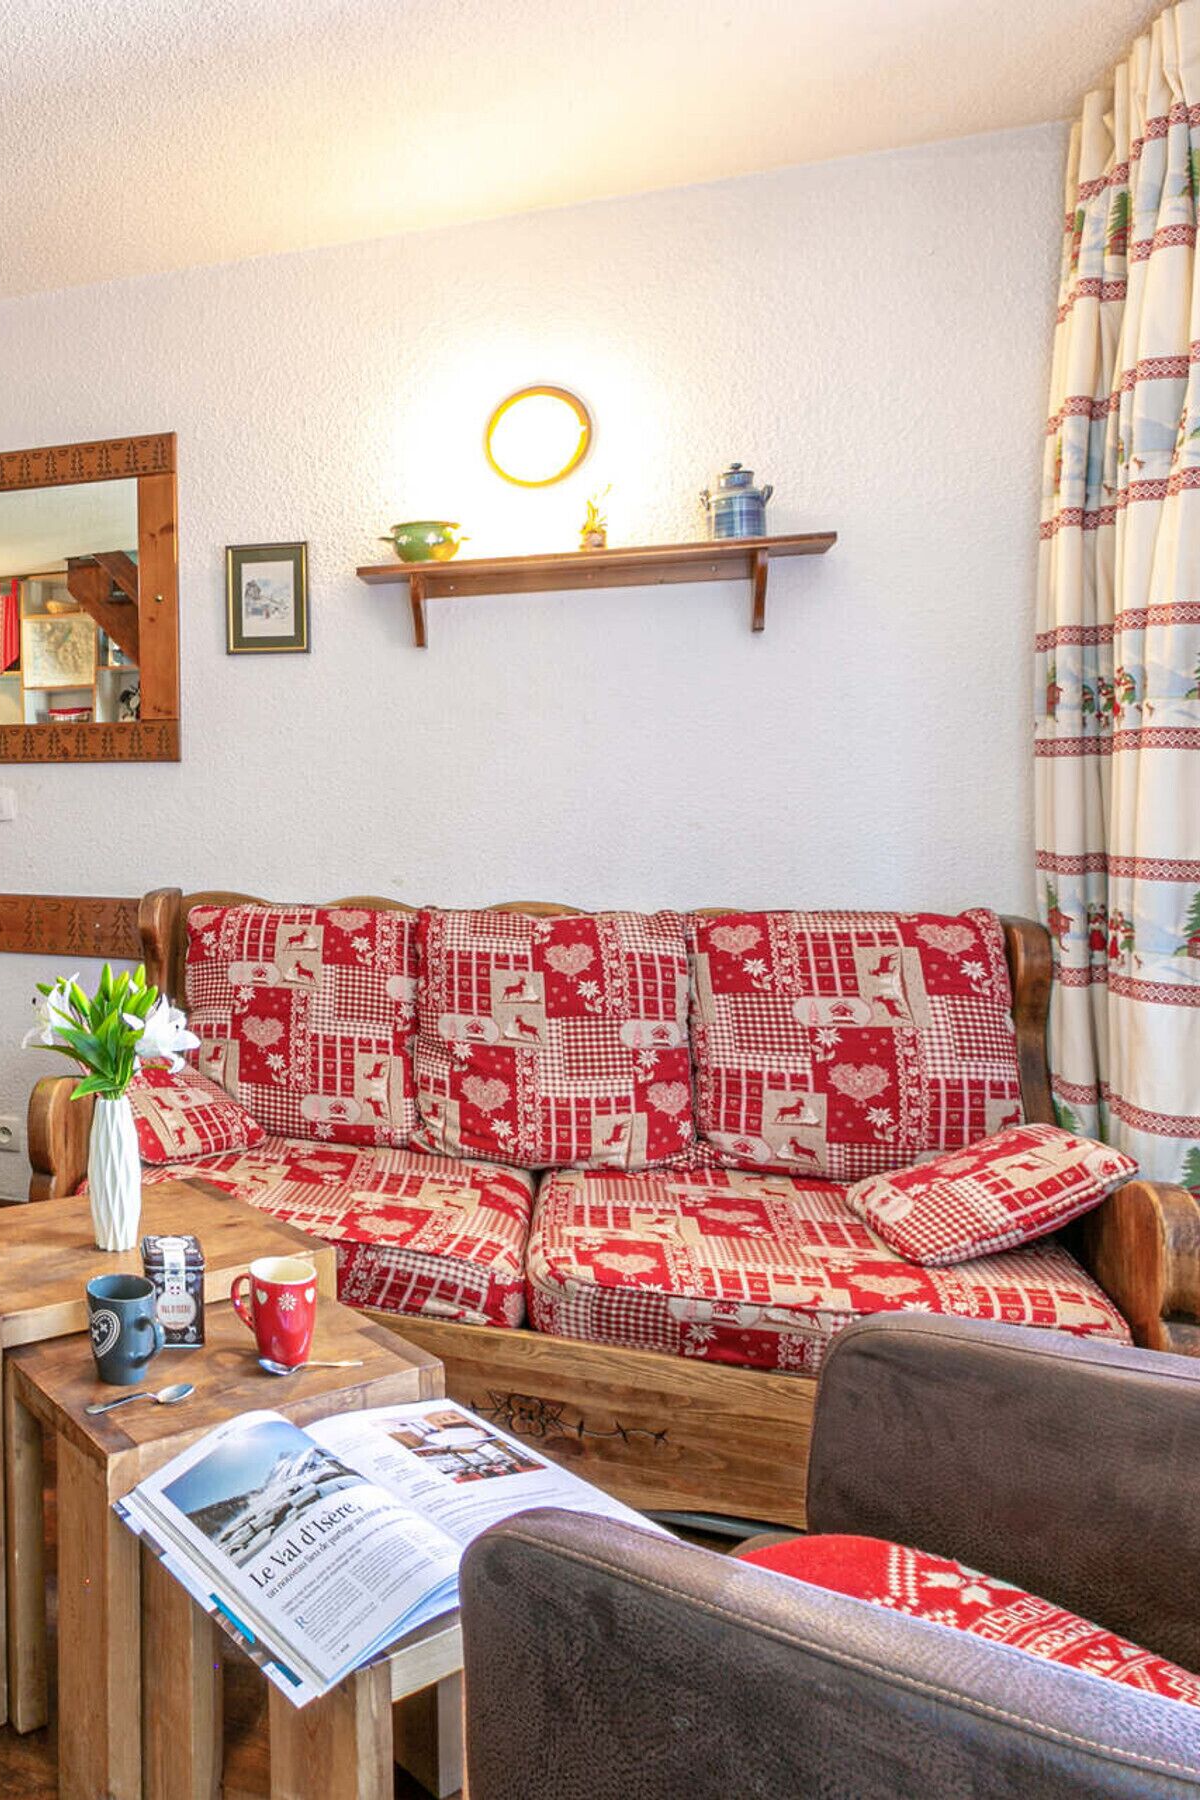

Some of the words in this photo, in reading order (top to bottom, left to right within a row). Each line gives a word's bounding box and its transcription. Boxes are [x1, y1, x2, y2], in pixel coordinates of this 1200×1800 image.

[248, 1566, 276, 1588] Le
[270, 1539, 302, 1567] Val
[299, 1502, 365, 1546] d'Isère,
[266, 1587, 280, 1599] un
[277, 1561, 308, 1591] nouveau
[304, 1550, 318, 1564] lieu
[318, 1540, 330, 1551] de
[327, 1522, 355, 1546] partage
